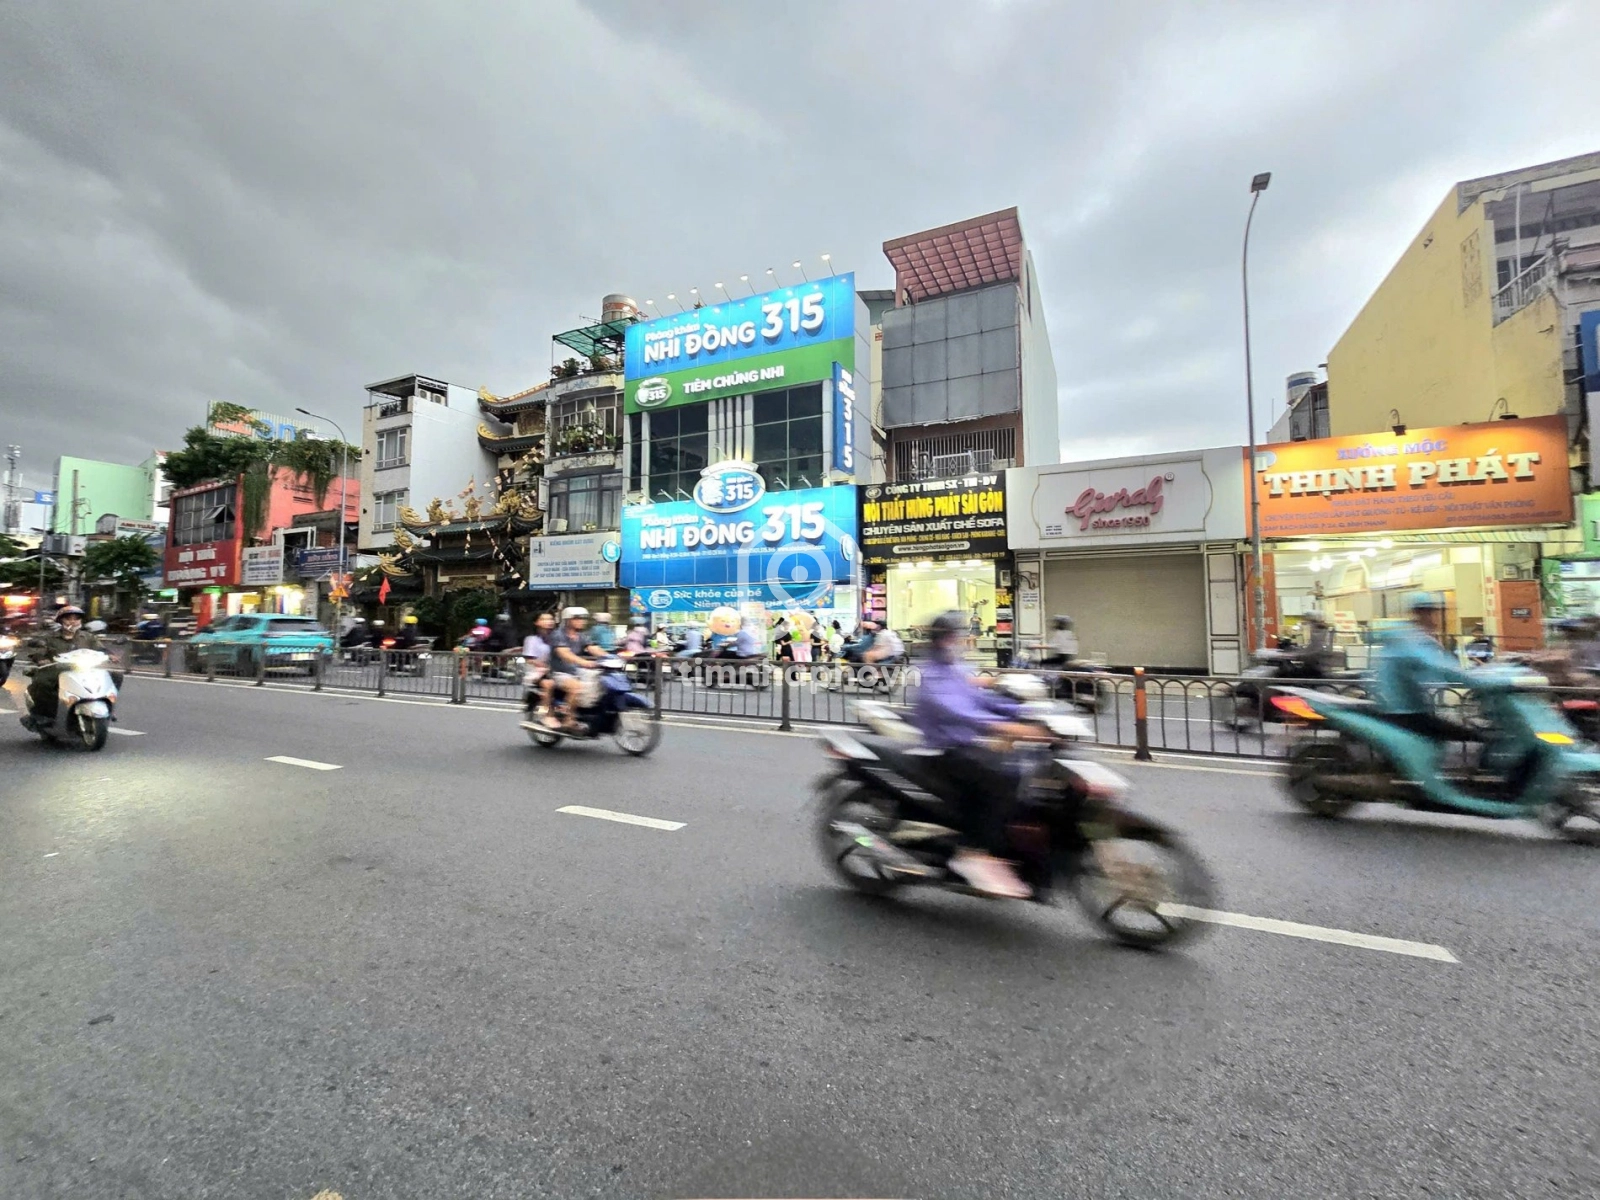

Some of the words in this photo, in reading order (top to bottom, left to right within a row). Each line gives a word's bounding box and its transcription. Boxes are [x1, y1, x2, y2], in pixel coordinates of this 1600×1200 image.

[644, 335, 680, 363] NHI
[684, 322, 756, 355] ĐỒNG
[760, 292, 824, 339] 315
[683, 377, 711, 394] TIÊM
[760, 364, 784, 380] NHI
[649, 389, 666, 401] 315
[1404, 439, 1448, 455] MỘC
[1264, 464, 1397, 496] THỊNH
[1407, 448, 1540, 485] PHÁT
[725, 483, 755, 501] 315
[909, 483, 921, 493] TY
[983, 475, 997, 486] DV
[863, 498, 880, 526] NỘI
[881, 494, 905, 521] THẤT
[934, 491, 960, 517] PHÁT
[961, 489, 979, 515] SÀI
[979, 487, 1003, 513] GÒN
[640, 525, 677, 550] NHI
[682, 515, 755, 547] ĐỒNG
[761, 502, 826, 542] 315
[863, 524, 902, 536] CHUYÊN
[903, 521, 925, 533] SẢN
[926, 517, 953, 532] XUẤT
[953, 515, 976, 529] GHẾ
[977, 517, 1005, 528] SOFA
[1092, 517, 1121, 529] since
[1123, 515, 1150, 527] 1950
[695, 590, 721, 598] khỏe
[724, 588, 745, 598] của
[747, 588, 762, 597] bé
[694, 600, 721, 609] Niềm
